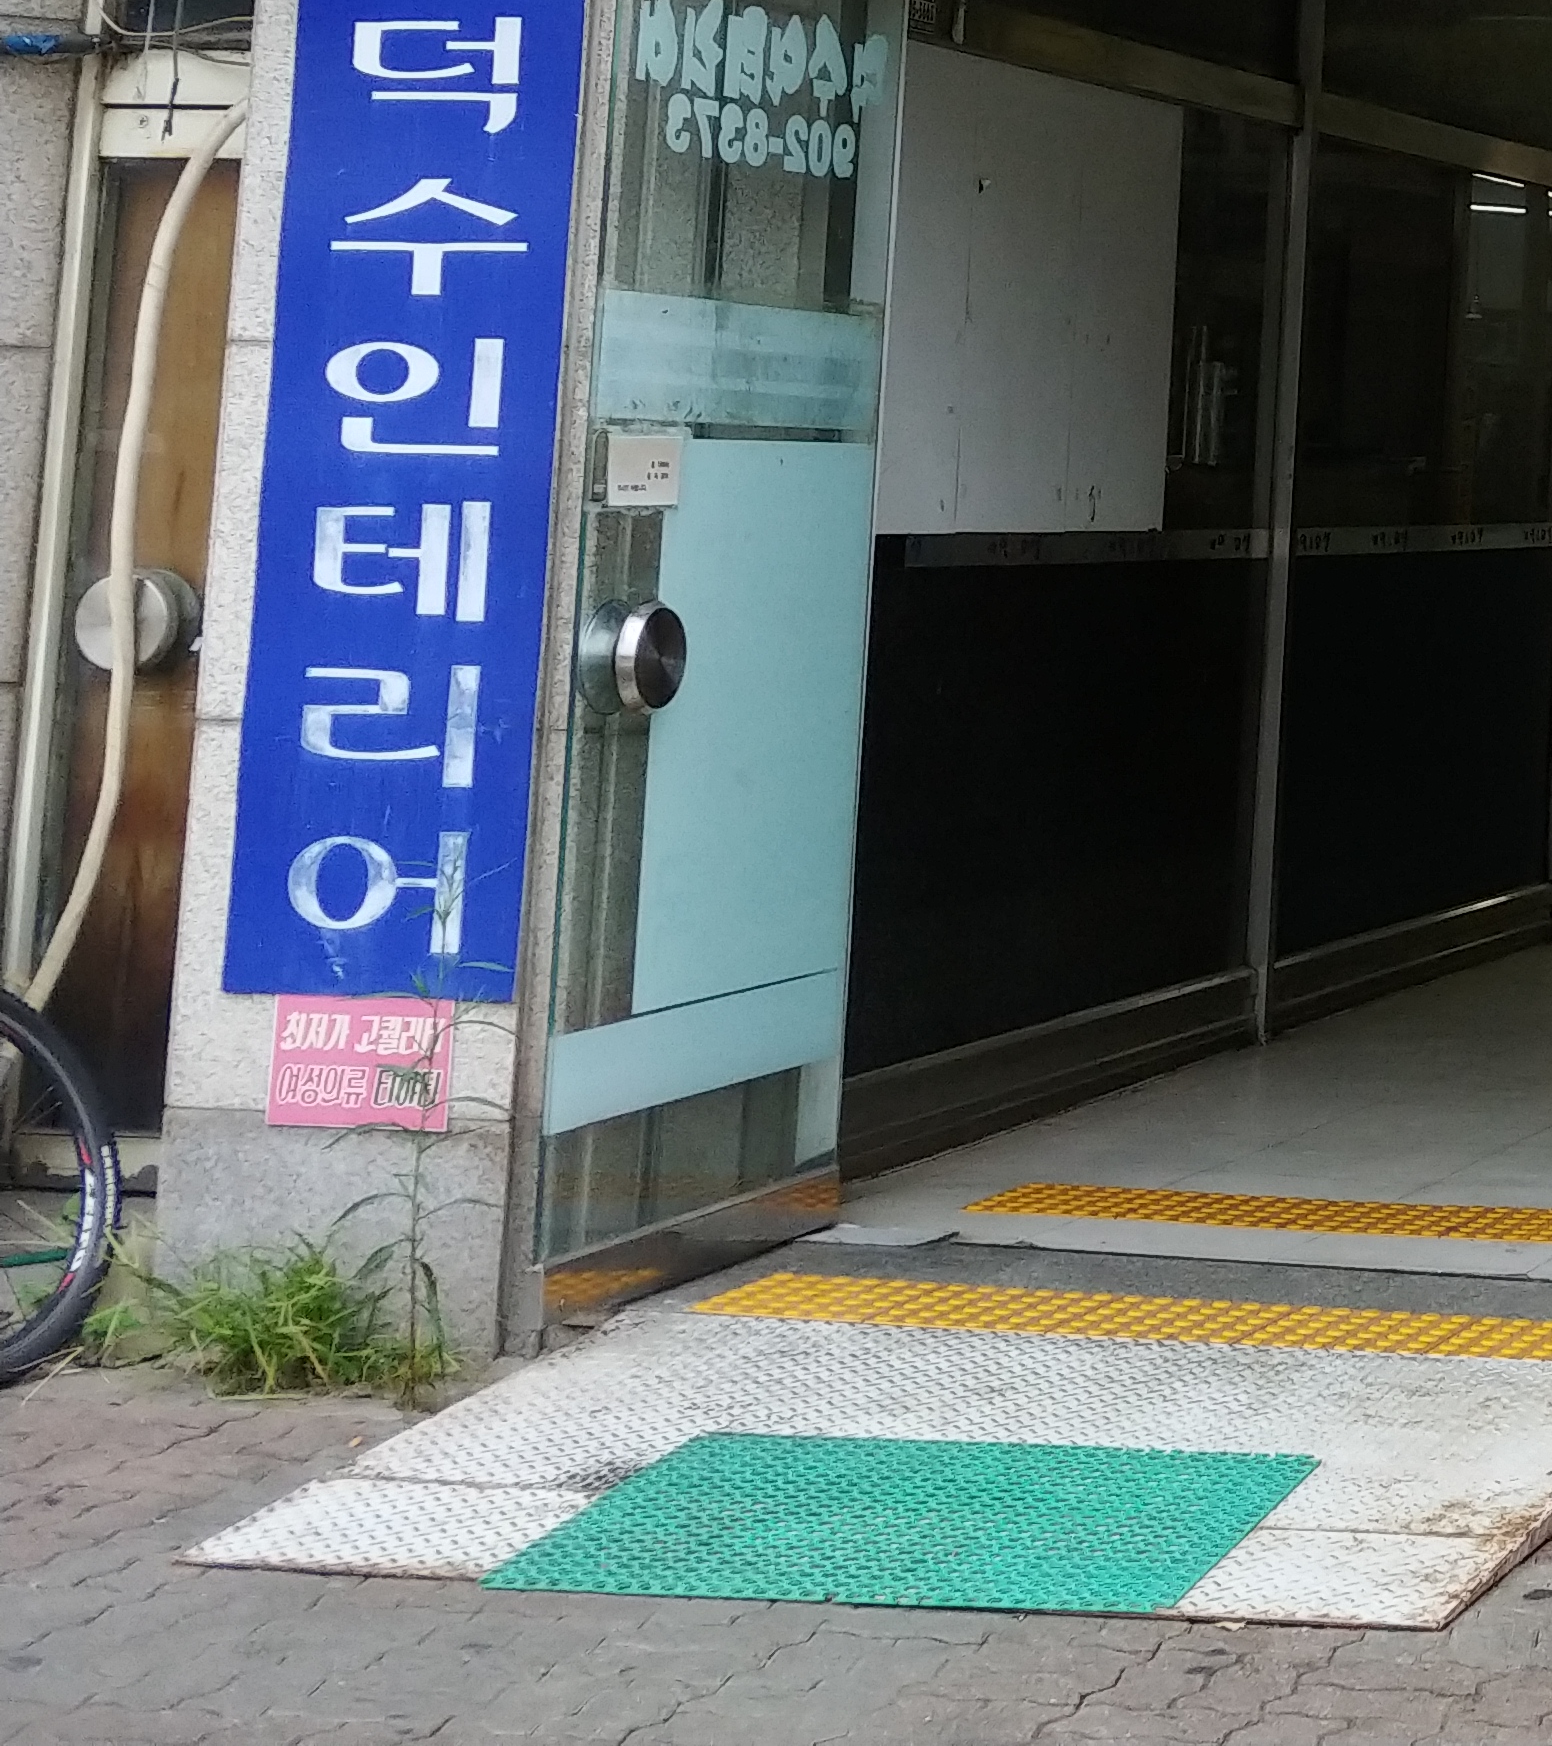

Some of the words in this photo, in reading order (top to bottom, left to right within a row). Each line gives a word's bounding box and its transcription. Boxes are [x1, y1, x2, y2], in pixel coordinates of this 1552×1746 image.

[288, 17, 528, 955] 덕수인테리어
[280, 1011, 351, 1051] 최저가
[277, 1063, 369, 1109] 여성의류
